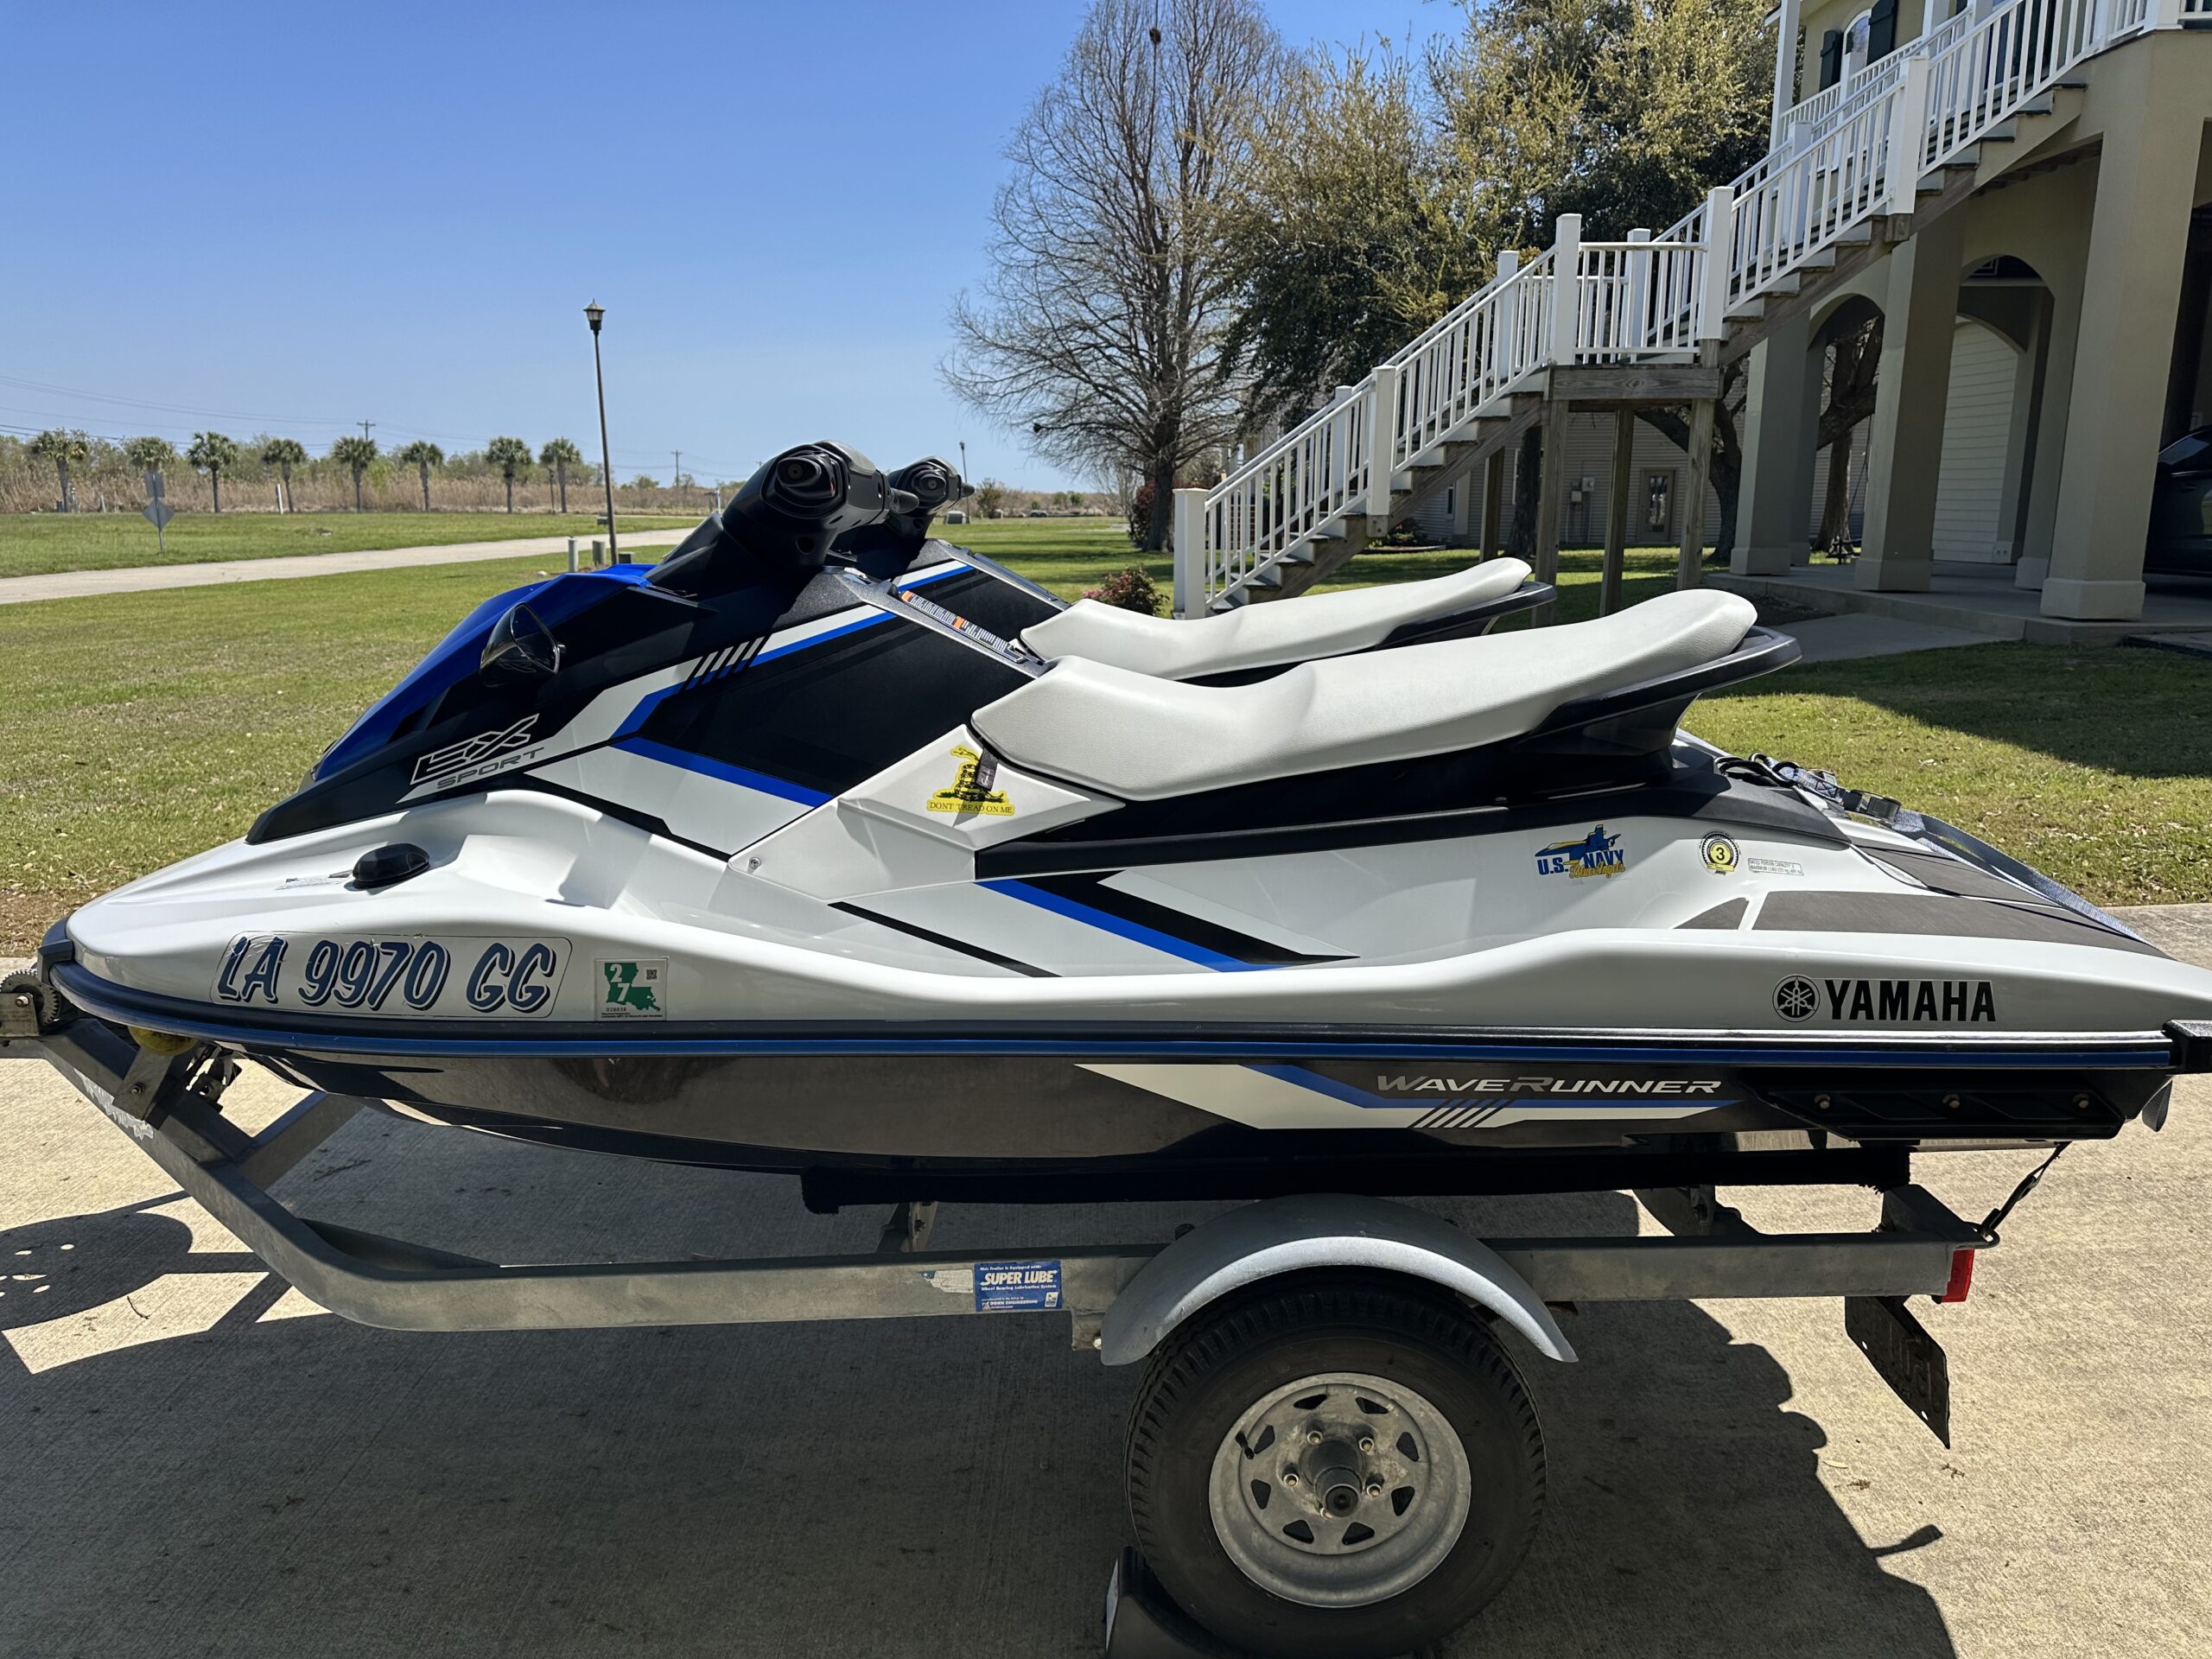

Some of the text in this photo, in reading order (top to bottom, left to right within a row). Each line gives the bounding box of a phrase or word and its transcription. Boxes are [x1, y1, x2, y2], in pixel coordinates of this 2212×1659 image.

[410, 713, 539, 785] EX
[436, 747, 544, 789] SPORT
[1537, 849, 1624, 875] U.S. NAVY
[1716, 847, 1726, 861] 3
[218, 936, 556, 1013] LA 9970 GG
[1824, 979, 1997, 1022] YAMAHA
[1377, 1075, 1722, 1094] WAVERUNNER
[980, 1270, 1058, 1287] SUPER LUBE
